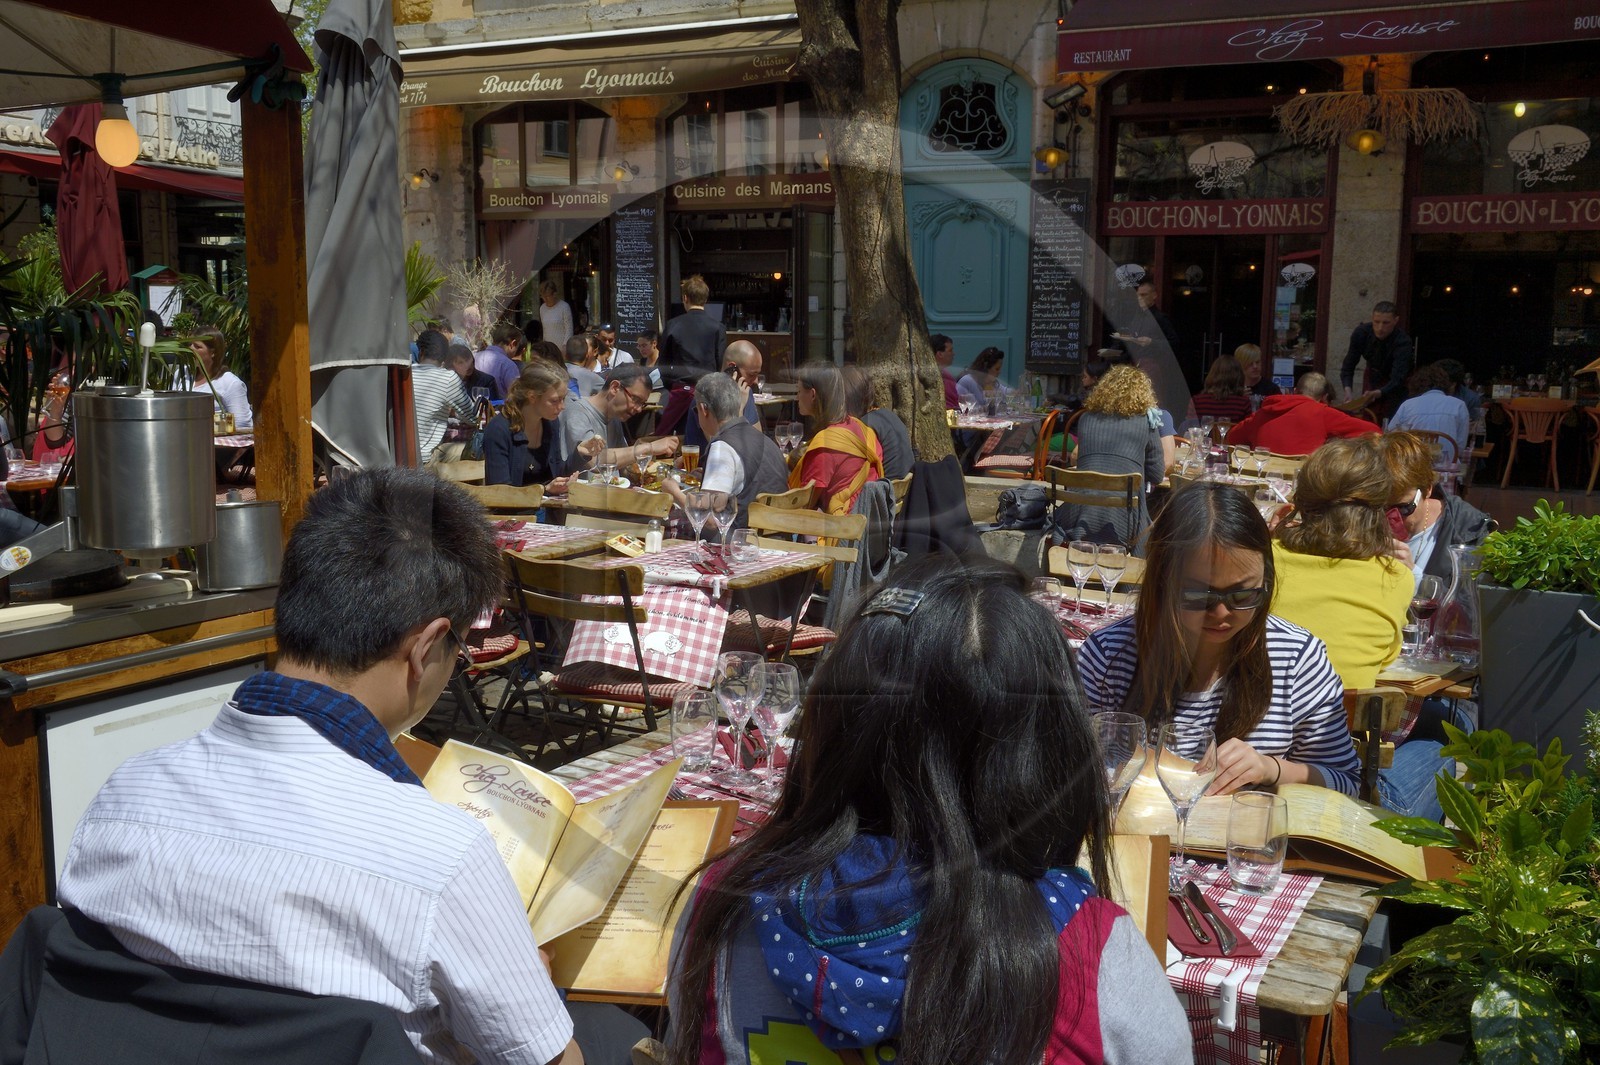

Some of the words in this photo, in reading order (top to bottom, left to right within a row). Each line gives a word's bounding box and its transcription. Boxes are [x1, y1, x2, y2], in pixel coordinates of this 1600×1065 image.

[1227, 19, 1324, 61] Chez
[1340, 19, 1461, 40] Louise
[752, 56, 790, 68] Cuisine
[1073, 48, 1132, 64] RESTAURANT
[400, 81, 428, 93] Grange
[479, 72, 564, 94] Bouchon
[580, 66, 675, 95] Lyonnais
[489, 193, 544, 208] Bouchon
[551, 191, 609, 208] Lyonnais
[674, 184, 727, 199] Cuisine
[735, 183, 761, 197] des
[770, 181, 832, 196] Mamans
[1217, 203, 1324, 228] LYONNAIS
[459, 763, 511, 793] Chez
[501, 780, 552, 807] Louise
[486, 788, 517, 804] BOUCHON
[516, 800, 546, 819] LYONNAIS
